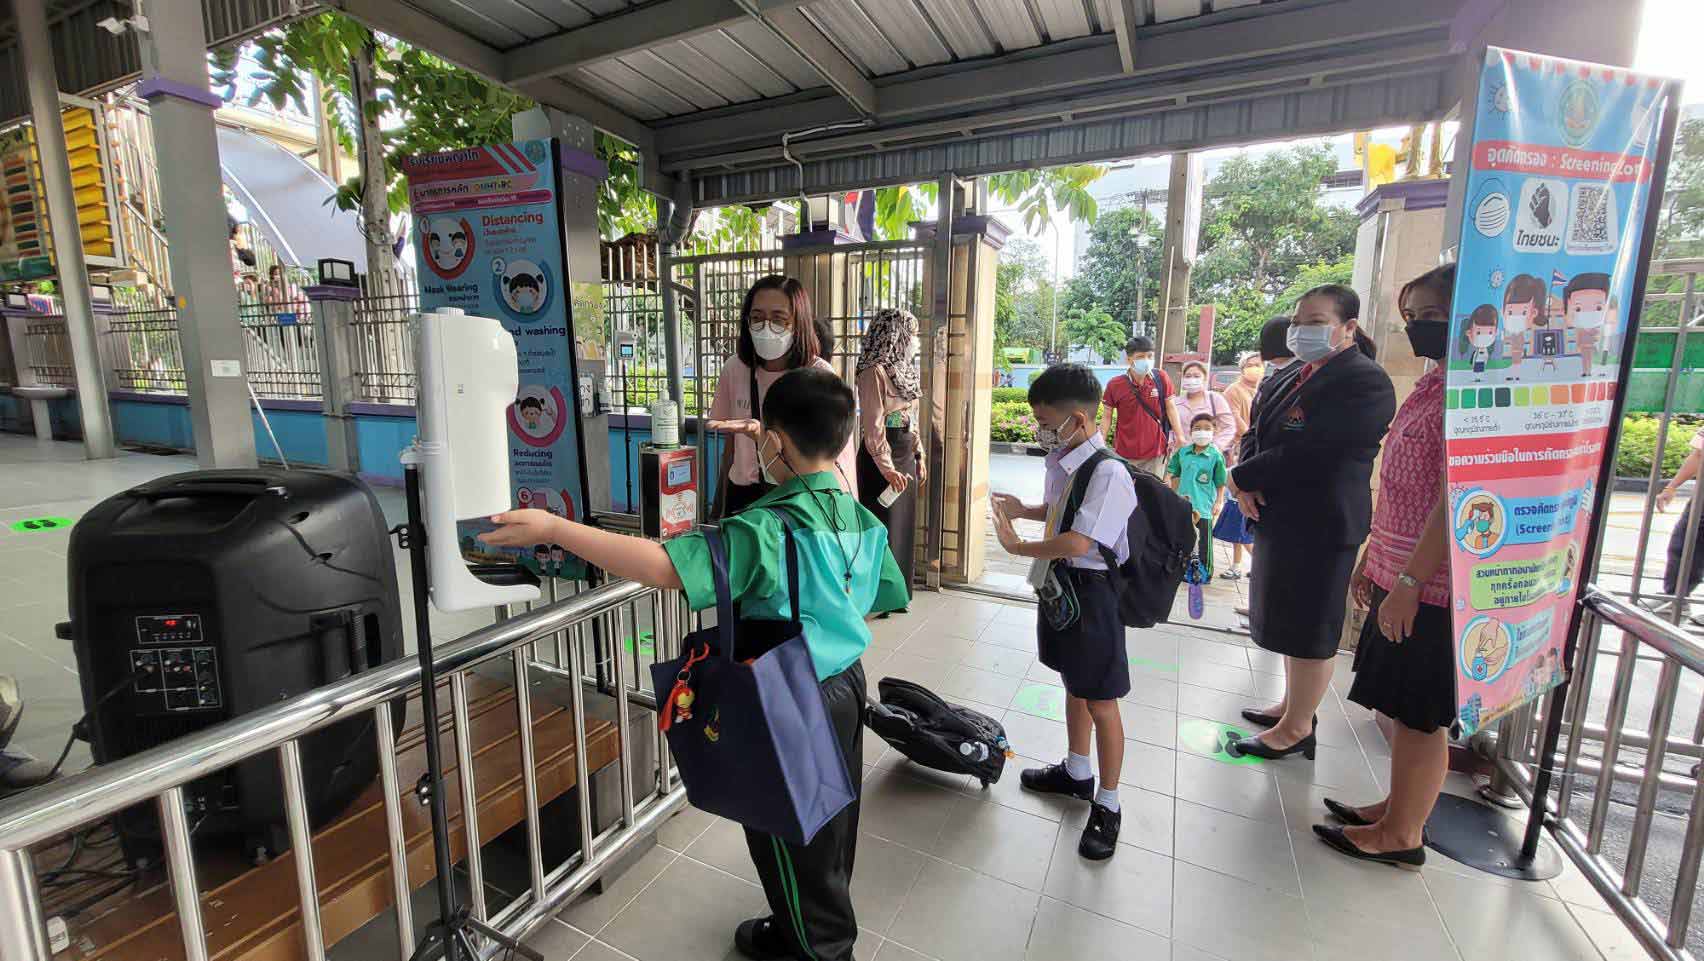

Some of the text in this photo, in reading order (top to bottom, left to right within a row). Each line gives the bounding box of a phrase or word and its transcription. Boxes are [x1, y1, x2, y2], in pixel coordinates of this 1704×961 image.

[482, 211, 545, 226] Distancing
[1516, 229, 1560, 247] ไทยชนะ
[494, 261, 503, 273] 2
[424, 285, 444, 294] Mask
[525, 325, 567, 337] washing
[512, 448, 553, 459] Reducing
[520, 490, 529, 500] 6
